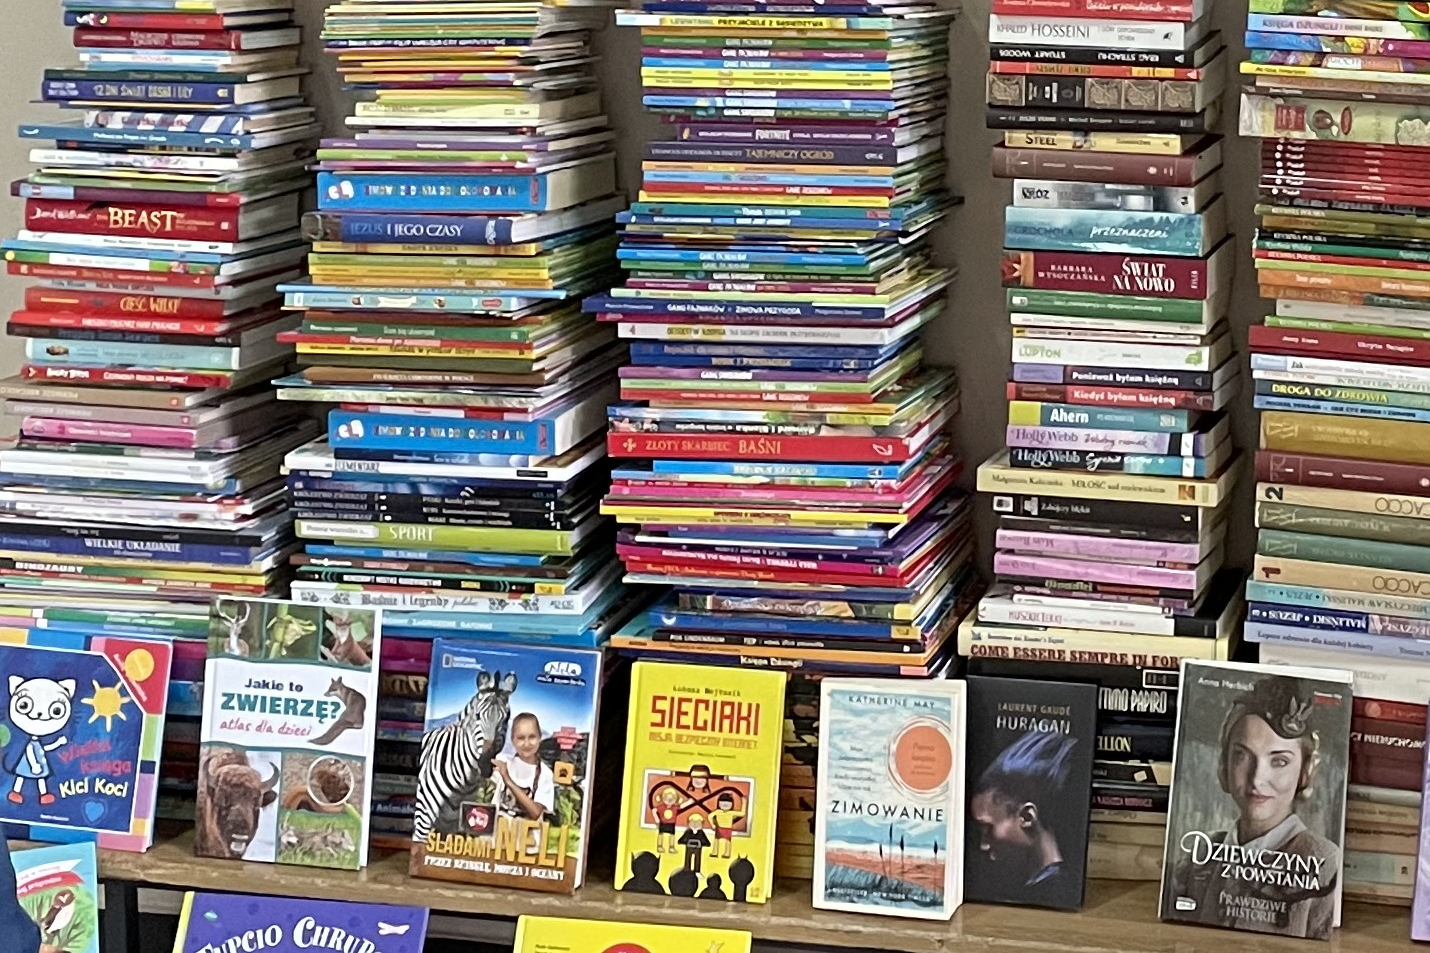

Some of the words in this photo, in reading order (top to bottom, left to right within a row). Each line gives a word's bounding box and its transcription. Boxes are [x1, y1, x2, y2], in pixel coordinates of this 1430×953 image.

[1031, 23, 1090, 39] HOSSEINI
[1025, 133, 1057, 146] STEEL
[108, 206, 178, 233] BEAST
[394, 224, 424, 237] JEGO
[426, 224, 464, 237] CZASY
[1089, 225, 1169, 239] przeznaczeni
[1121, 257, 1166, 278] ŚWIAT
[1112, 274, 1131, 290] NA
[1134, 276, 1175, 292] NOWO
[1272, 383, 1310, 396] DROGA
[1315, 387, 1332, 397] DO
[1335, 389, 1390, 404] ZDROWIA
[1050, 409, 1089, 424] Ahern
[1047, 430, 1078, 442] Webb
[738, 437, 781, 455] BAŚNI
[1050, 450, 1080, 463] Webb
[389, 525, 436, 541] SPORT
[970, 644, 1010, 656] COME
[1013, 646, 1068, 660] ESSERE
[1070, 649, 1128, 664] SEMPRE
[1133, 654, 1147, 666] IN
[245, 678, 283, 692] Jakie
[289, 682, 303, 693] to
[221, 692, 342, 724] ZWIERZĘ?
[848, 695, 908, 709] KATHERINE
[998, 702, 1038, 715] LAURENT
[1130, 689, 1168, 714] PAPIRO
[649, 695, 761, 736] SIECIAKI
[220, 719, 252, 733] atlas
[255, 722, 274, 734] dla
[278, 723, 312, 737] dzieci
[996, 716, 1071, 735] HURAGAN
[830, 799, 944, 823] ZIMOWANIE
[426, 828, 492, 860] ŚLADAMI
[496, 816, 570, 869] NELI
[1180, 831, 1325, 875] DZIEWCZYNY
[1235, 866, 1320, 891] POWSTANIA
[1219, 891, 1287, 914] PRAWDZIWE
[1226, 906, 1277, 924] HISTORIE
